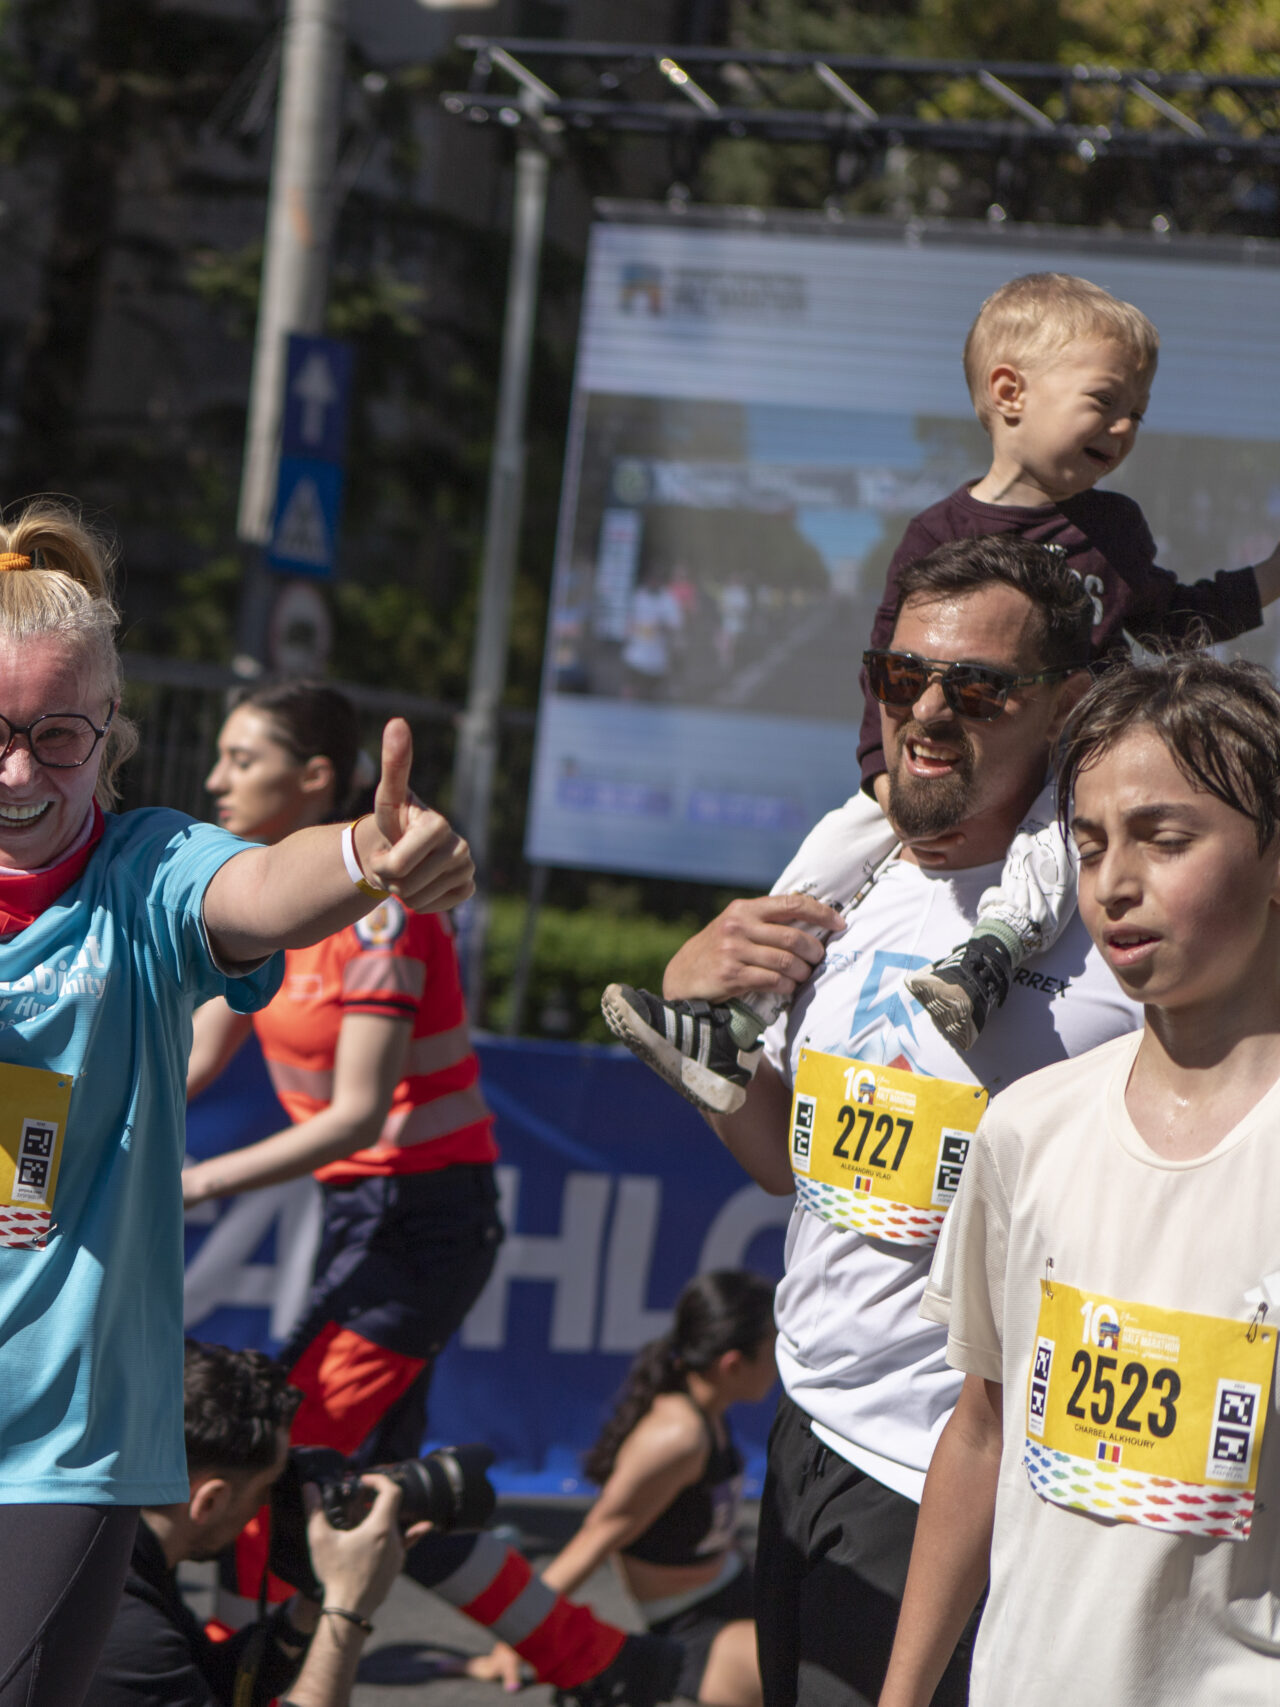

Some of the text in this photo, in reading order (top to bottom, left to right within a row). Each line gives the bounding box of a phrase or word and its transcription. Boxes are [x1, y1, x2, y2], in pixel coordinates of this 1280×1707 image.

[1012, 966, 1072, 998] RREX
[832, 1105, 914, 1171] 2727
[840, 1162, 874, 1177] ALEXANDRU
[1066, 1349, 1181, 1438] 2523
[1074, 1424, 1156, 1449] CHARBEL ALKHOURY
